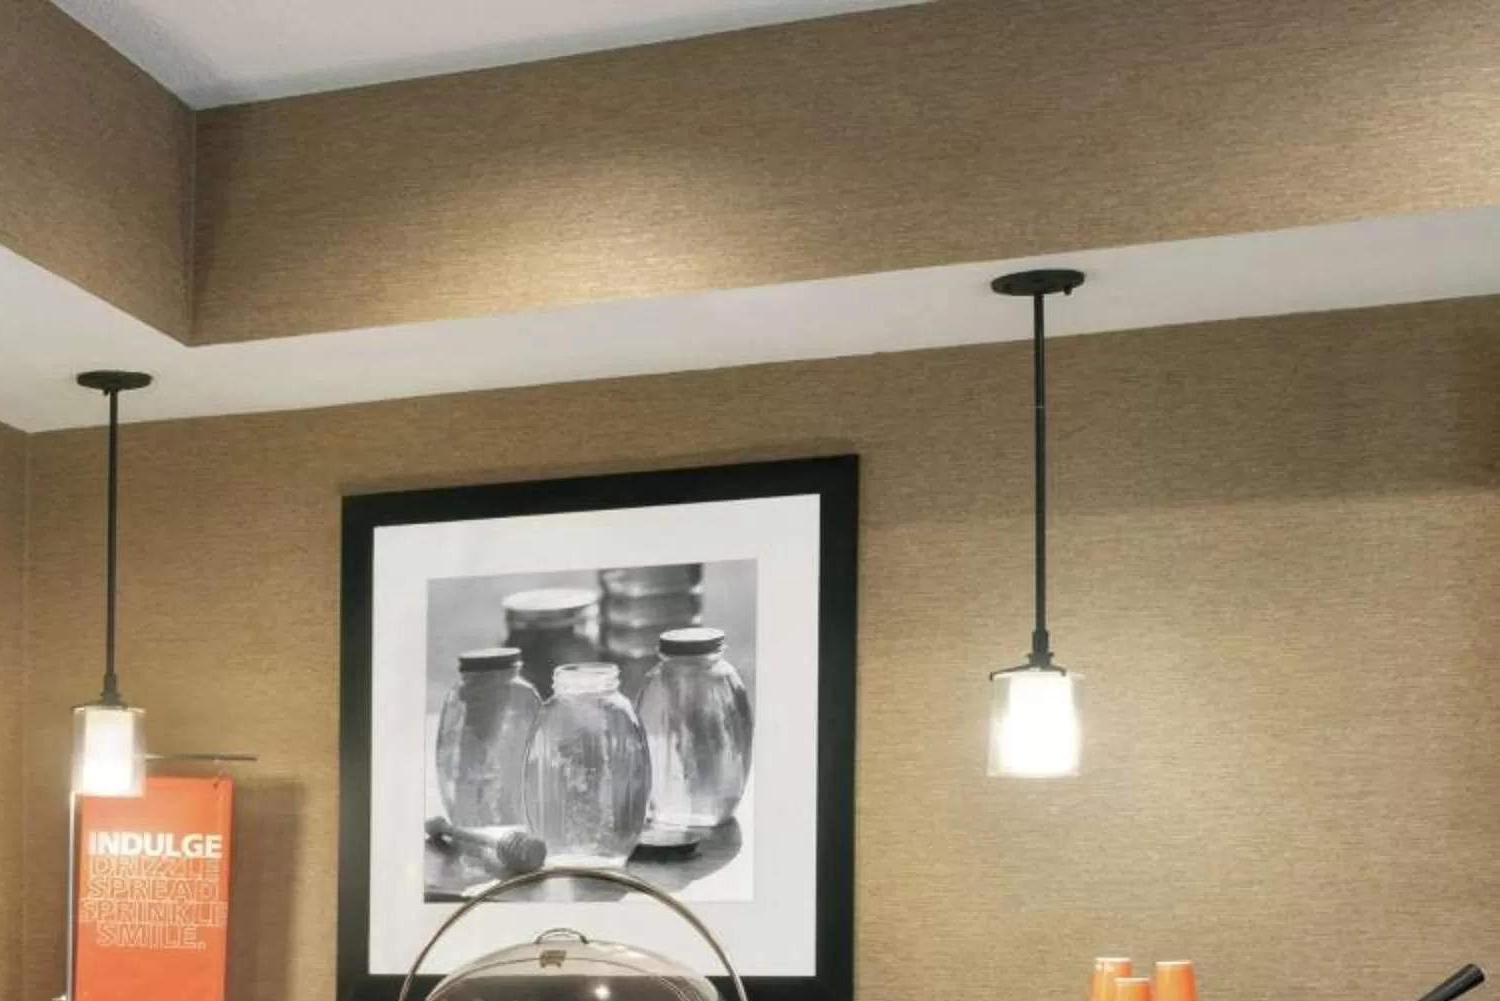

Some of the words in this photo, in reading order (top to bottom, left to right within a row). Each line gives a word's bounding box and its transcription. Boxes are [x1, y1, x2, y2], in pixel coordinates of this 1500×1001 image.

[88, 831, 222, 859] INDULGE
[90, 857, 220, 878] DRIZZLE
[87, 877, 219, 900] SPREAD
[81, 899, 228, 924] SPRINKLE
